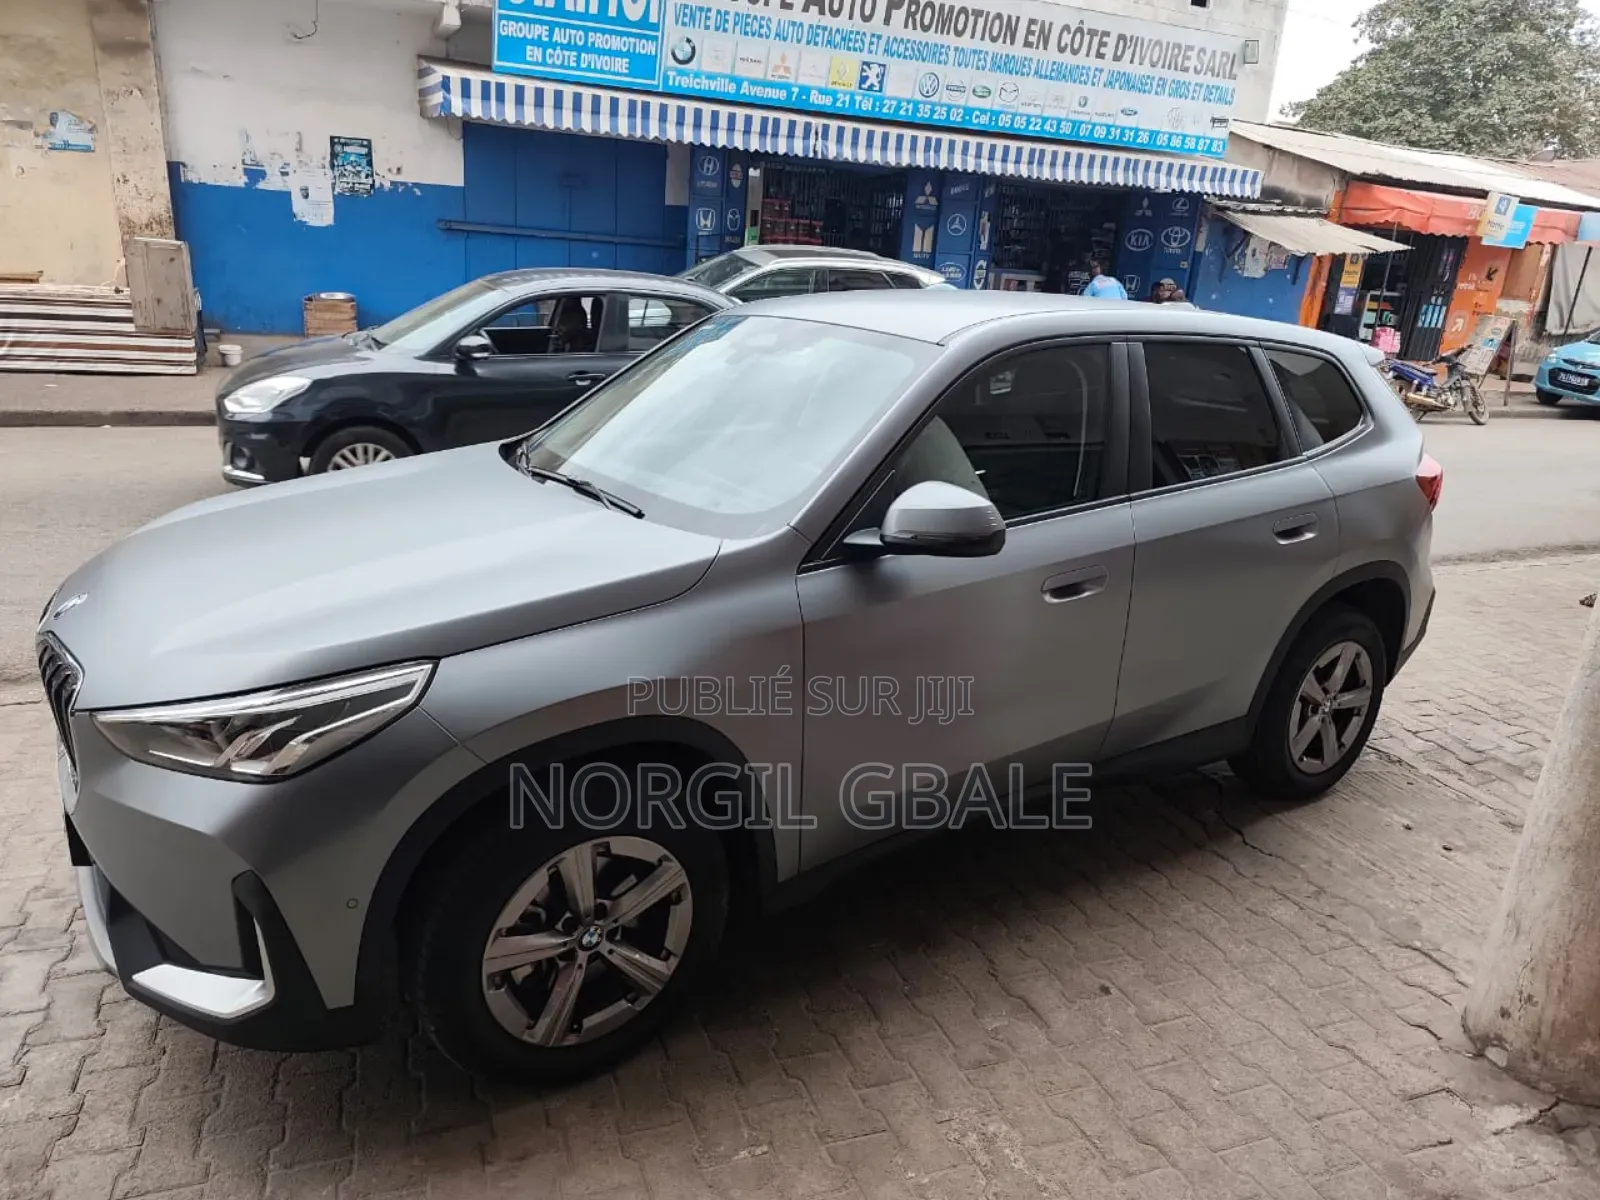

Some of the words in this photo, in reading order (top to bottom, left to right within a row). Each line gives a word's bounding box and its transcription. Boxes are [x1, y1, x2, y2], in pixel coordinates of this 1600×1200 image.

[500, 20, 549, 41] GROUPE
[552, 27, 584, 46] AUTO
[588, 32, 656, 56] PROMOTION
[525, 46, 542, 63] EN
[546, 46, 577, 67] CÔTE
[580, 54, 630, 73] D'IVOIRE
[674, 2, 712, 31] VENTE
[714, 9, 731, 33] DE
[774, 19, 804, 44] AUTO
[868, 32, 883, 56] ET
[883, 35, 951, 66] ACCESSOIRES
[953, 46, 990, 72] TOUTES
[989, 51, 1033, 77] MARQUES
[1033, 59, 1091, 86] ALLEMANDES
[1091, 67, 1105, 87] ET
[1103, 69, 1156, 95] JAPONAISES
[1154, 77, 1169, 97] EN
[1168, 79, 1193, 101] GROS
[1190, 83, 1205, 102] ET
[883, 0, 1020, 46] PROMOTION
[1022, 17, 1053, 51] EN
[1057, 20, 1110, 60] CÔTE
[1112, 33, 1195, 73] D'IVOIRE
[1193, 46, 1238, 81] SARL
[667, 70, 737, 94] Treichville
[740, 80, 787, 101] Avenue
[791, 87, 799, 102] 7
[810, 89, 833, 106] Rue
[835, 92, 851, 108] 21
[882, 99, 897, 114] 27
[899, 102, 914, 116] 21
[916, 103, 931, 118] 35
[933, 105, 947, 120] 25
[950, 107, 964, 122] 02
[998, 113, 1012, 127] 05
[1013, 115, 1027, 129] 05
[1028, 117, 1042, 131] 22
[1043, 119, 1057, 133] 43
[1059, 121, 1072, 135] 50
[1080, 123, 1094, 136] 07
[1093, 125, 1107, 139] 09
[1108, 126, 1121, 140] 31
[1122, 128, 1136, 142] 31
[1135, 130, 1150, 144] 26
[1156, 132, 1170, 146] 05
[1130, 234, 1150, 246] KIA
